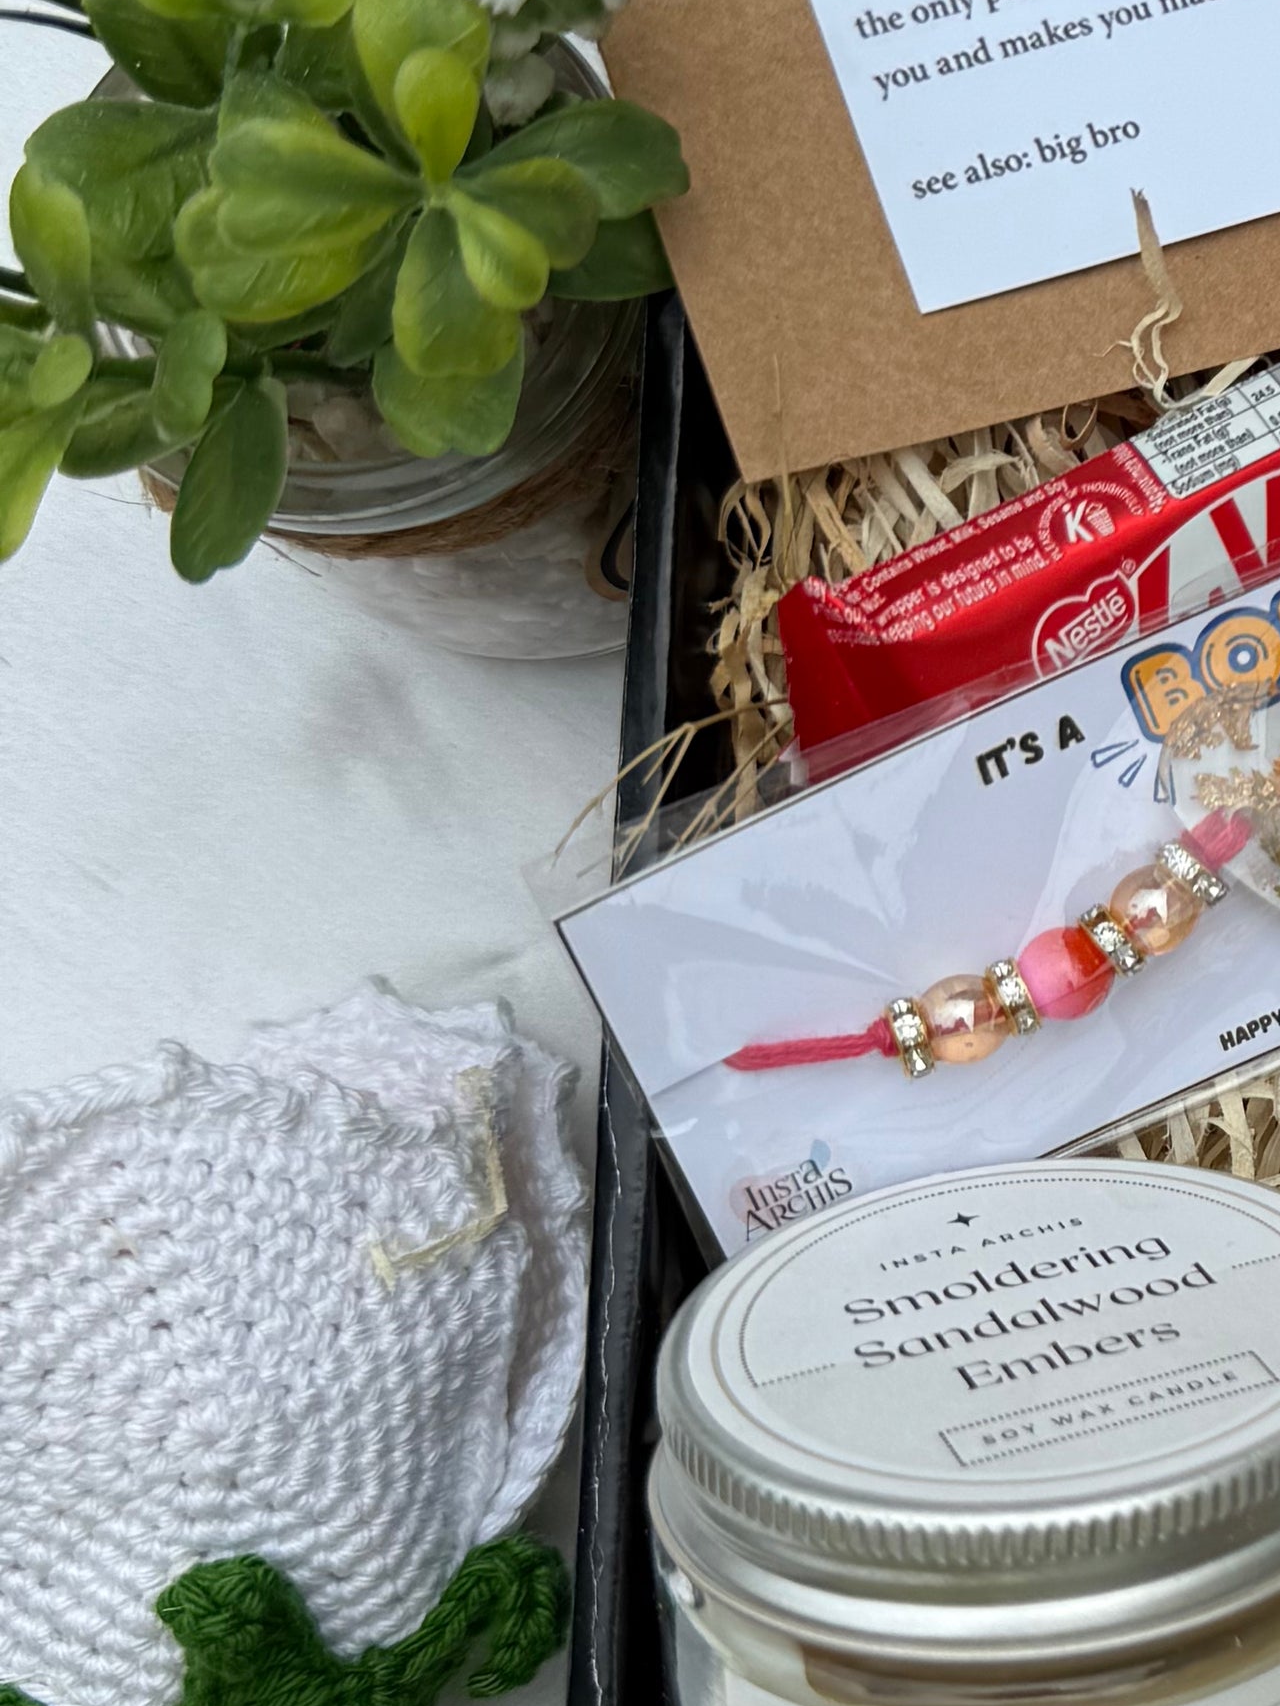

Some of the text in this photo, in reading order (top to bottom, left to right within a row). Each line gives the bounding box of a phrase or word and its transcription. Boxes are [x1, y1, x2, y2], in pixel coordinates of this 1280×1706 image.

[855, 10, 905, 39] the
[874, 63, 931, 101] you
[936, 36, 994, 76] and
[998, 18, 1093, 59] makes
[1097, 1, 1153, 39] you
[911, 120, 1141, 199] see also: big bro
[974, 731, 1045, 787] IT'S
[1057, 714, 1085, 754] A
[743, 1166, 854, 1243] ARCHIS
[843, 1237, 1172, 1325] Smoldering
[880, 1218, 1083, 1271] INSTA ARCHIS
[853, 1261, 1217, 1369] Sandalwood
[955, 1322, 1181, 1391] Embers
[982, 1371, 1237, 1446] SOY WAX CANDLE
